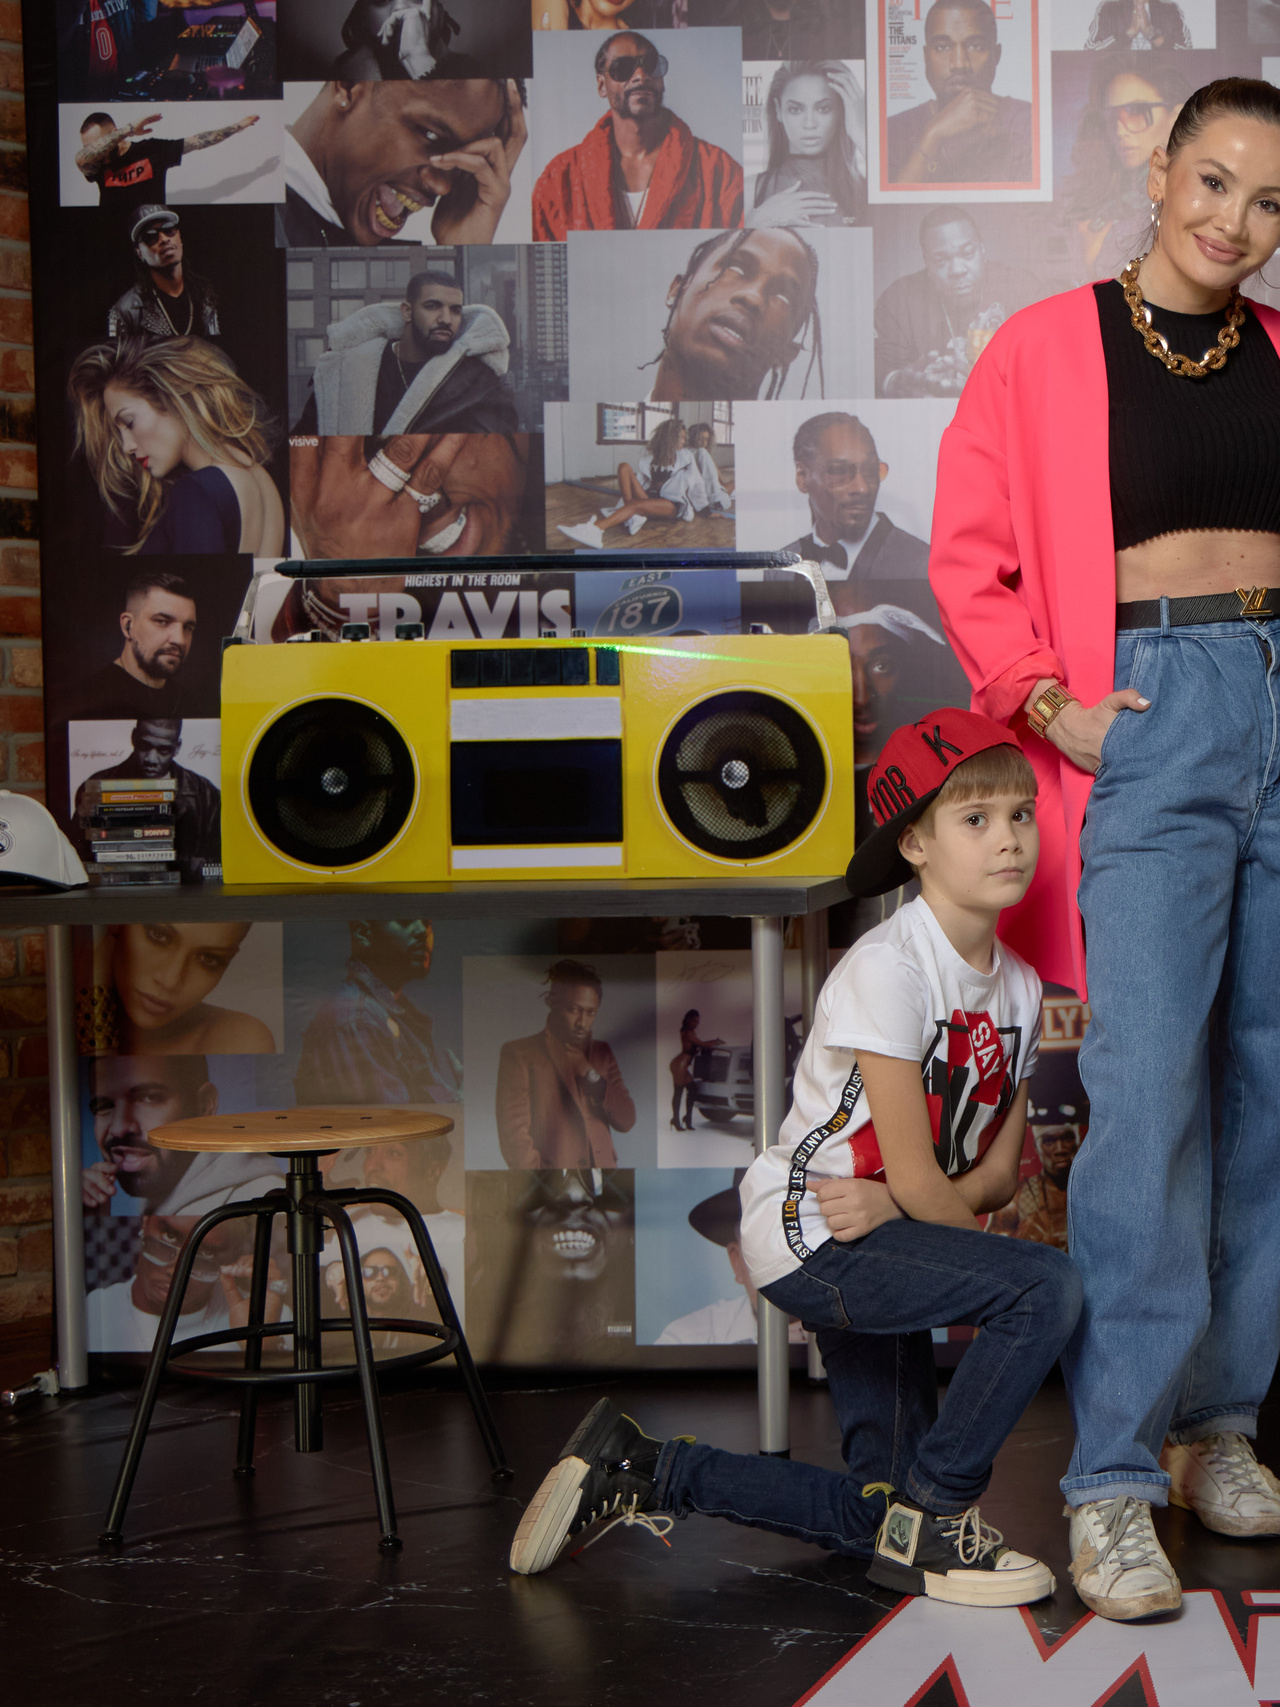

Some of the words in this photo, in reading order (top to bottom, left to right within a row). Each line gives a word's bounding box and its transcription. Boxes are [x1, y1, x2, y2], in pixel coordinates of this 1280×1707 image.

[888, 26, 904, 35] THE
[888, 35, 917, 45] TITANS
[405, 575, 449, 587] HIGHEST
[451, 574, 466, 587] IN
[468, 574, 488, 586] THE
[490, 573, 521, 586] ROOM
[629, 572, 663, 587] EAST
[612, 589, 668, 608] CALIFORNIA
[611, 597, 671, 631] 187
[921, 725, 964, 767] K
[828, 1111, 849, 1131] NOT
